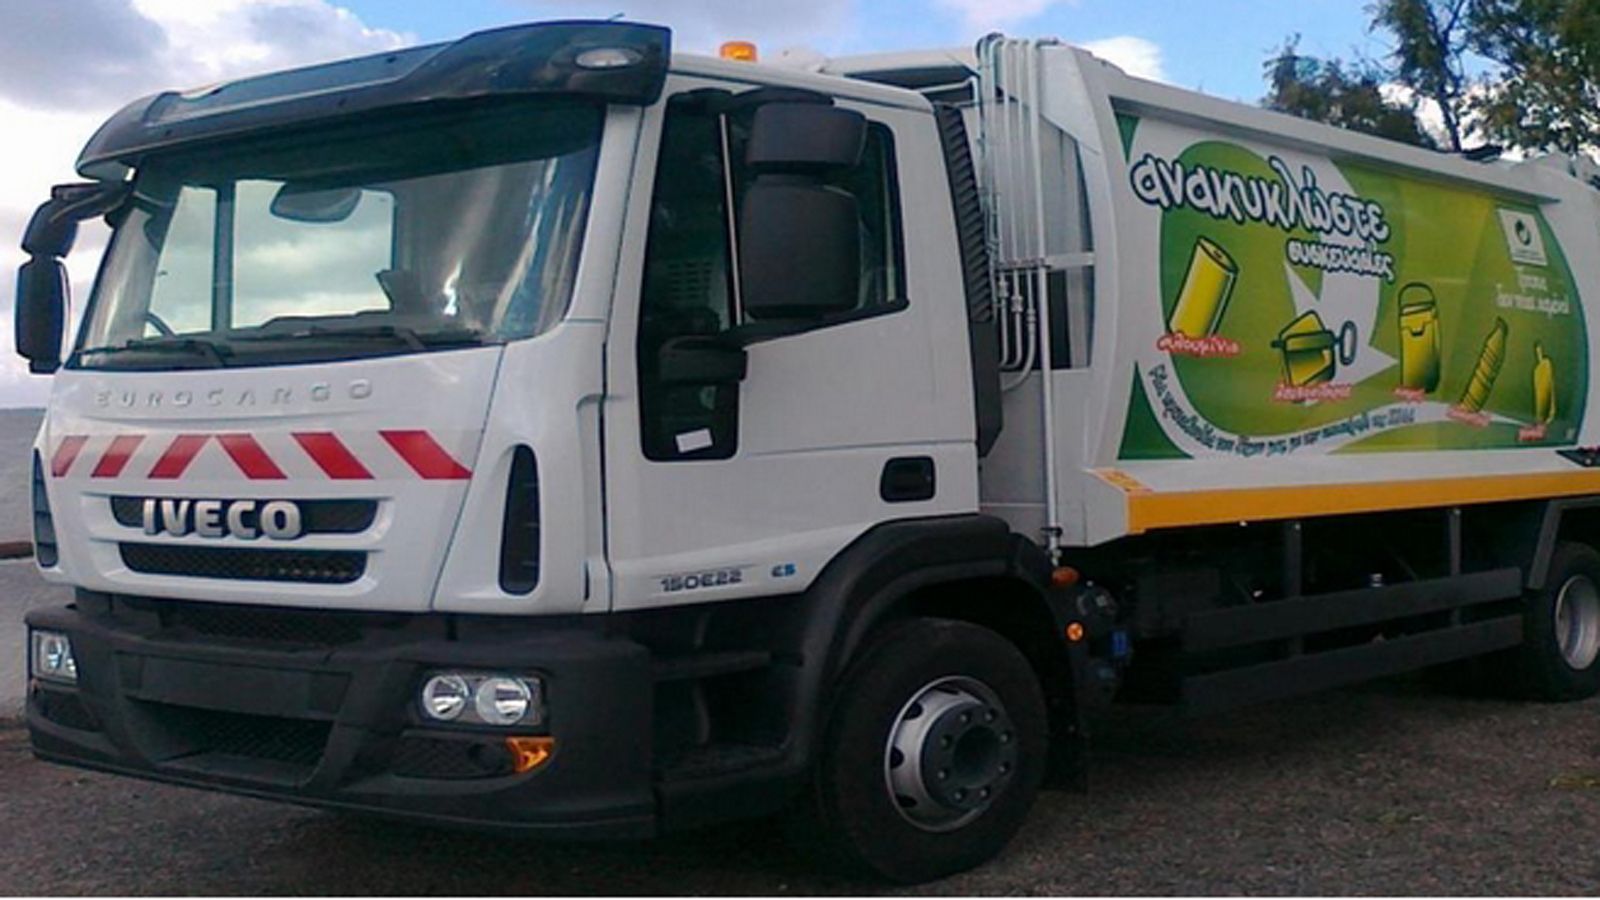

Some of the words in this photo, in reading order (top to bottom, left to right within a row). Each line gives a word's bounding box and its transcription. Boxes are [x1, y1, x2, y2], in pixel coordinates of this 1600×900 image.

[95, 378, 374, 408] EUROCARGO
[142, 498, 303, 540] IVECO
[660, 569, 742, 593] 150E22
